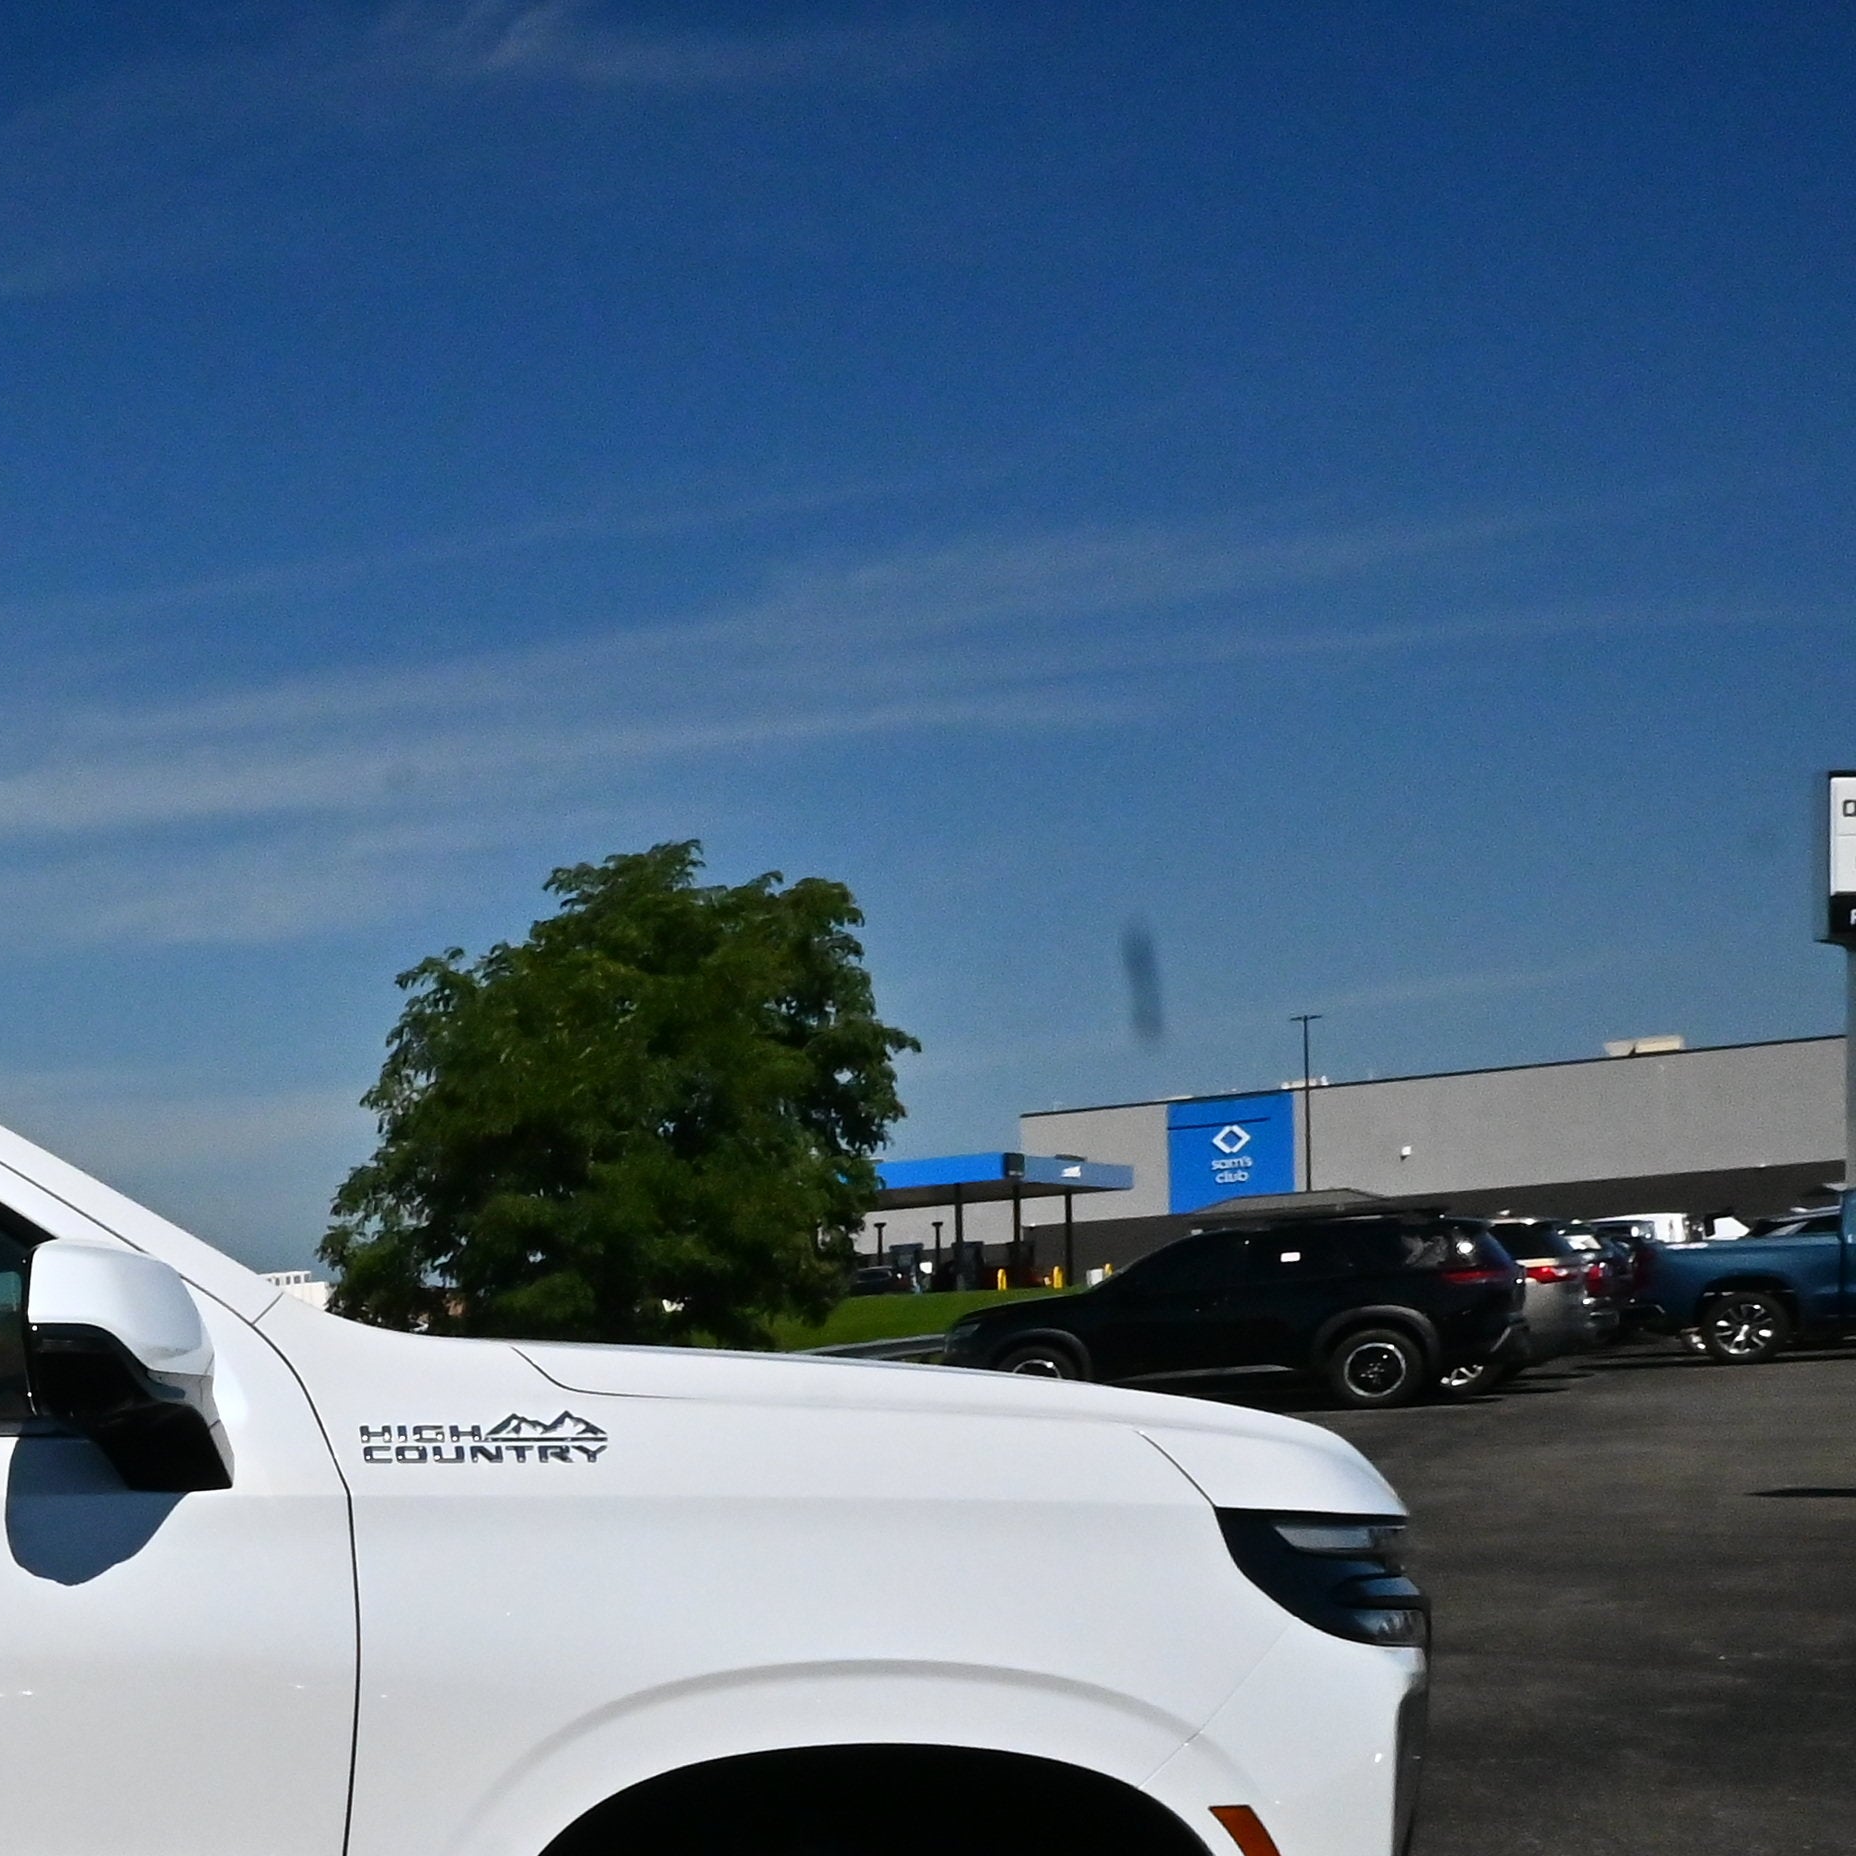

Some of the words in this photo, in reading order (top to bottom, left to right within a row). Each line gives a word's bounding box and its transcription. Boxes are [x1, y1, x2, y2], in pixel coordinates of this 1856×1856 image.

[1211, 1156, 1254, 1171] sam's
[1215, 1169, 1249, 1184] club
[359, 1425, 482, 1443] HIGH
[362, 1445, 608, 1463] COUNTRY
